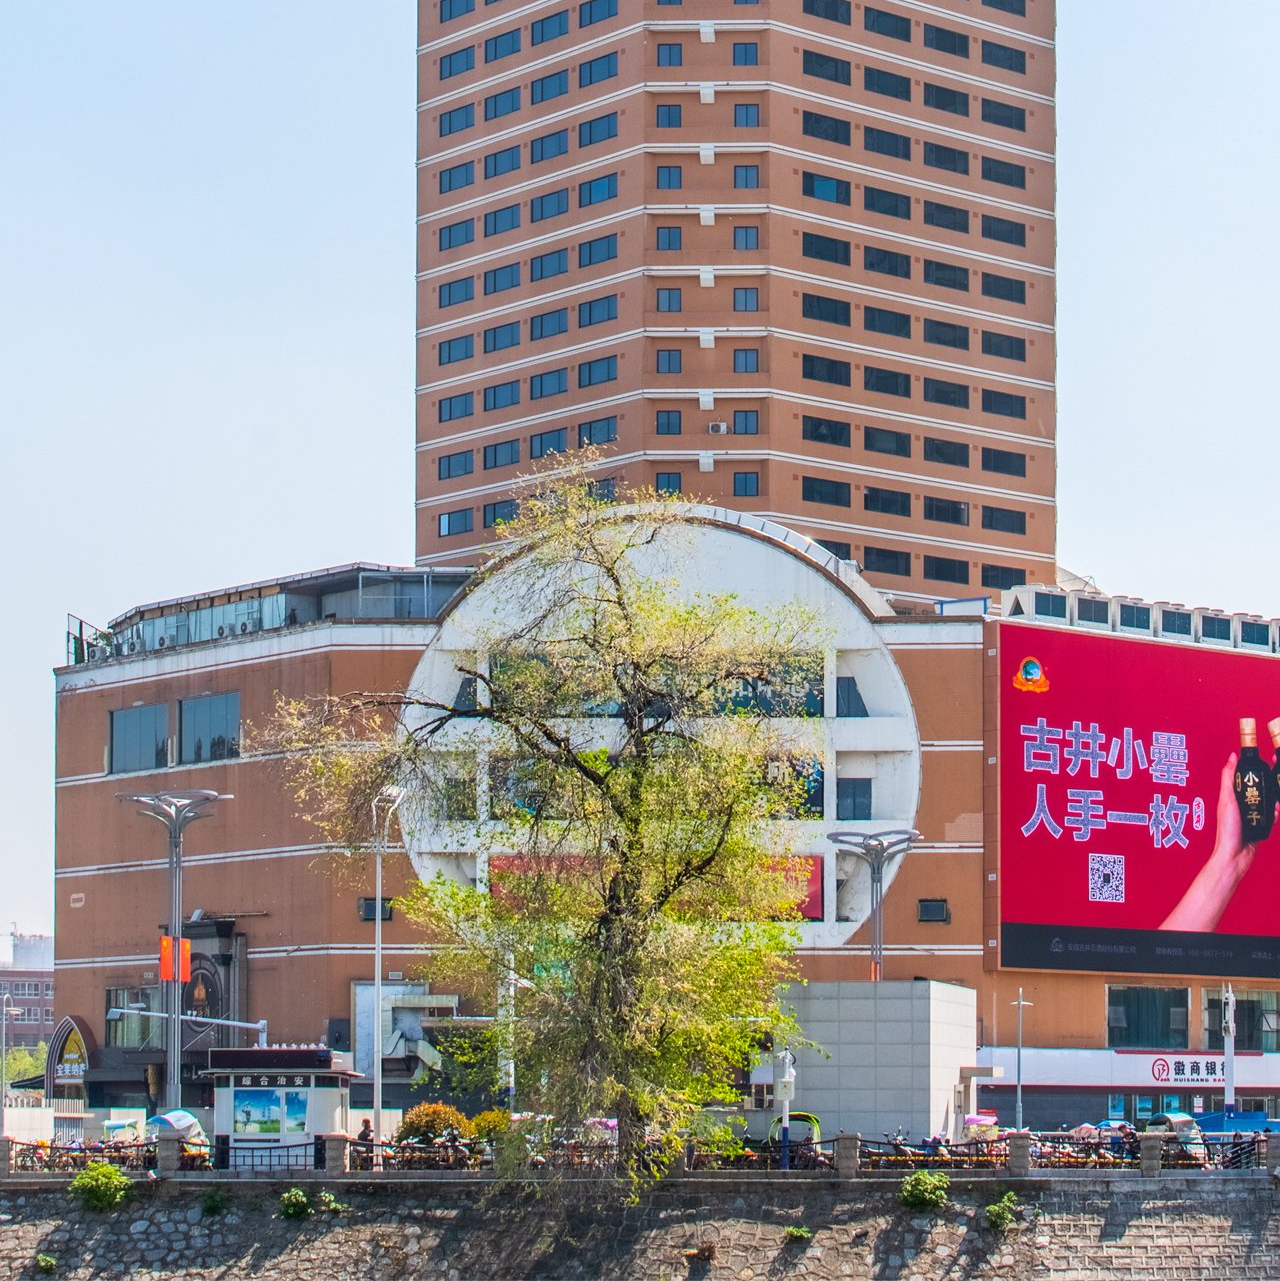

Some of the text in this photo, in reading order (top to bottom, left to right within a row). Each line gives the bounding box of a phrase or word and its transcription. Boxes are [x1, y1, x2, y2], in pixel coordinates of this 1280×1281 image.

[1020, 717, 1191, 786] 古井小罍
[1020, 783, 1191, 849] 人手一枚
[241, 1076, 305, 1086] 综合治安
